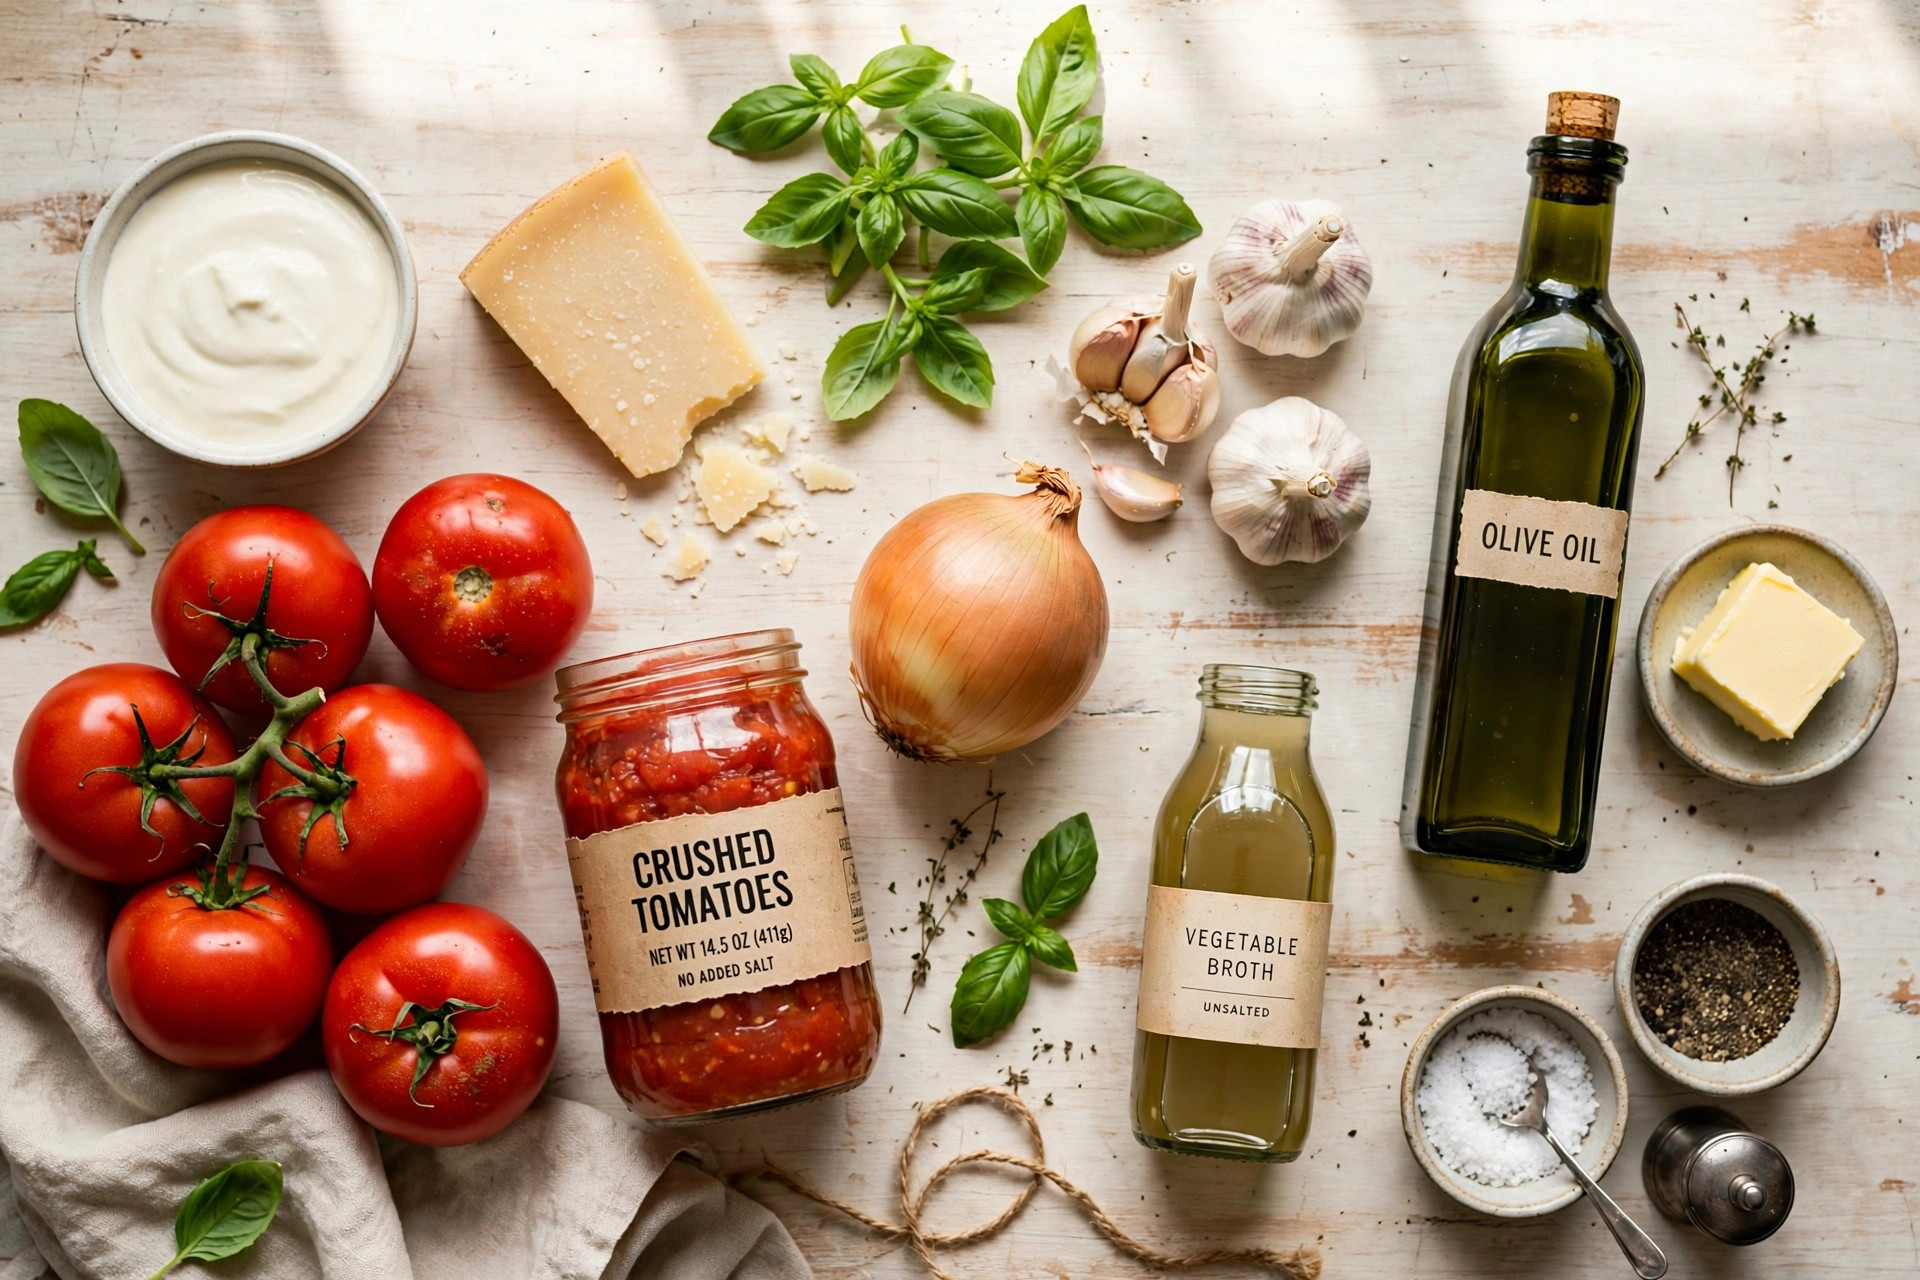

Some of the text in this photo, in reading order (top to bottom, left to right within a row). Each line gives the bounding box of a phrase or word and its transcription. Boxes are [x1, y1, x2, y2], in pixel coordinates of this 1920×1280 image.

[1482, 522, 1601, 564] OLIVE OIL
[633, 829, 775, 888] CRUSHED
[631, 871, 793, 933] TOMATOES
[649, 923, 793, 966] NET WT 14.5 OZ (411g)
[1186, 928, 1298, 955] VEGETABLE
[678, 956, 774, 987] NO ADDED SALT
[1208, 958, 1273, 981] BROTH
[1204, 1002, 1269, 1017] UNSALTED
